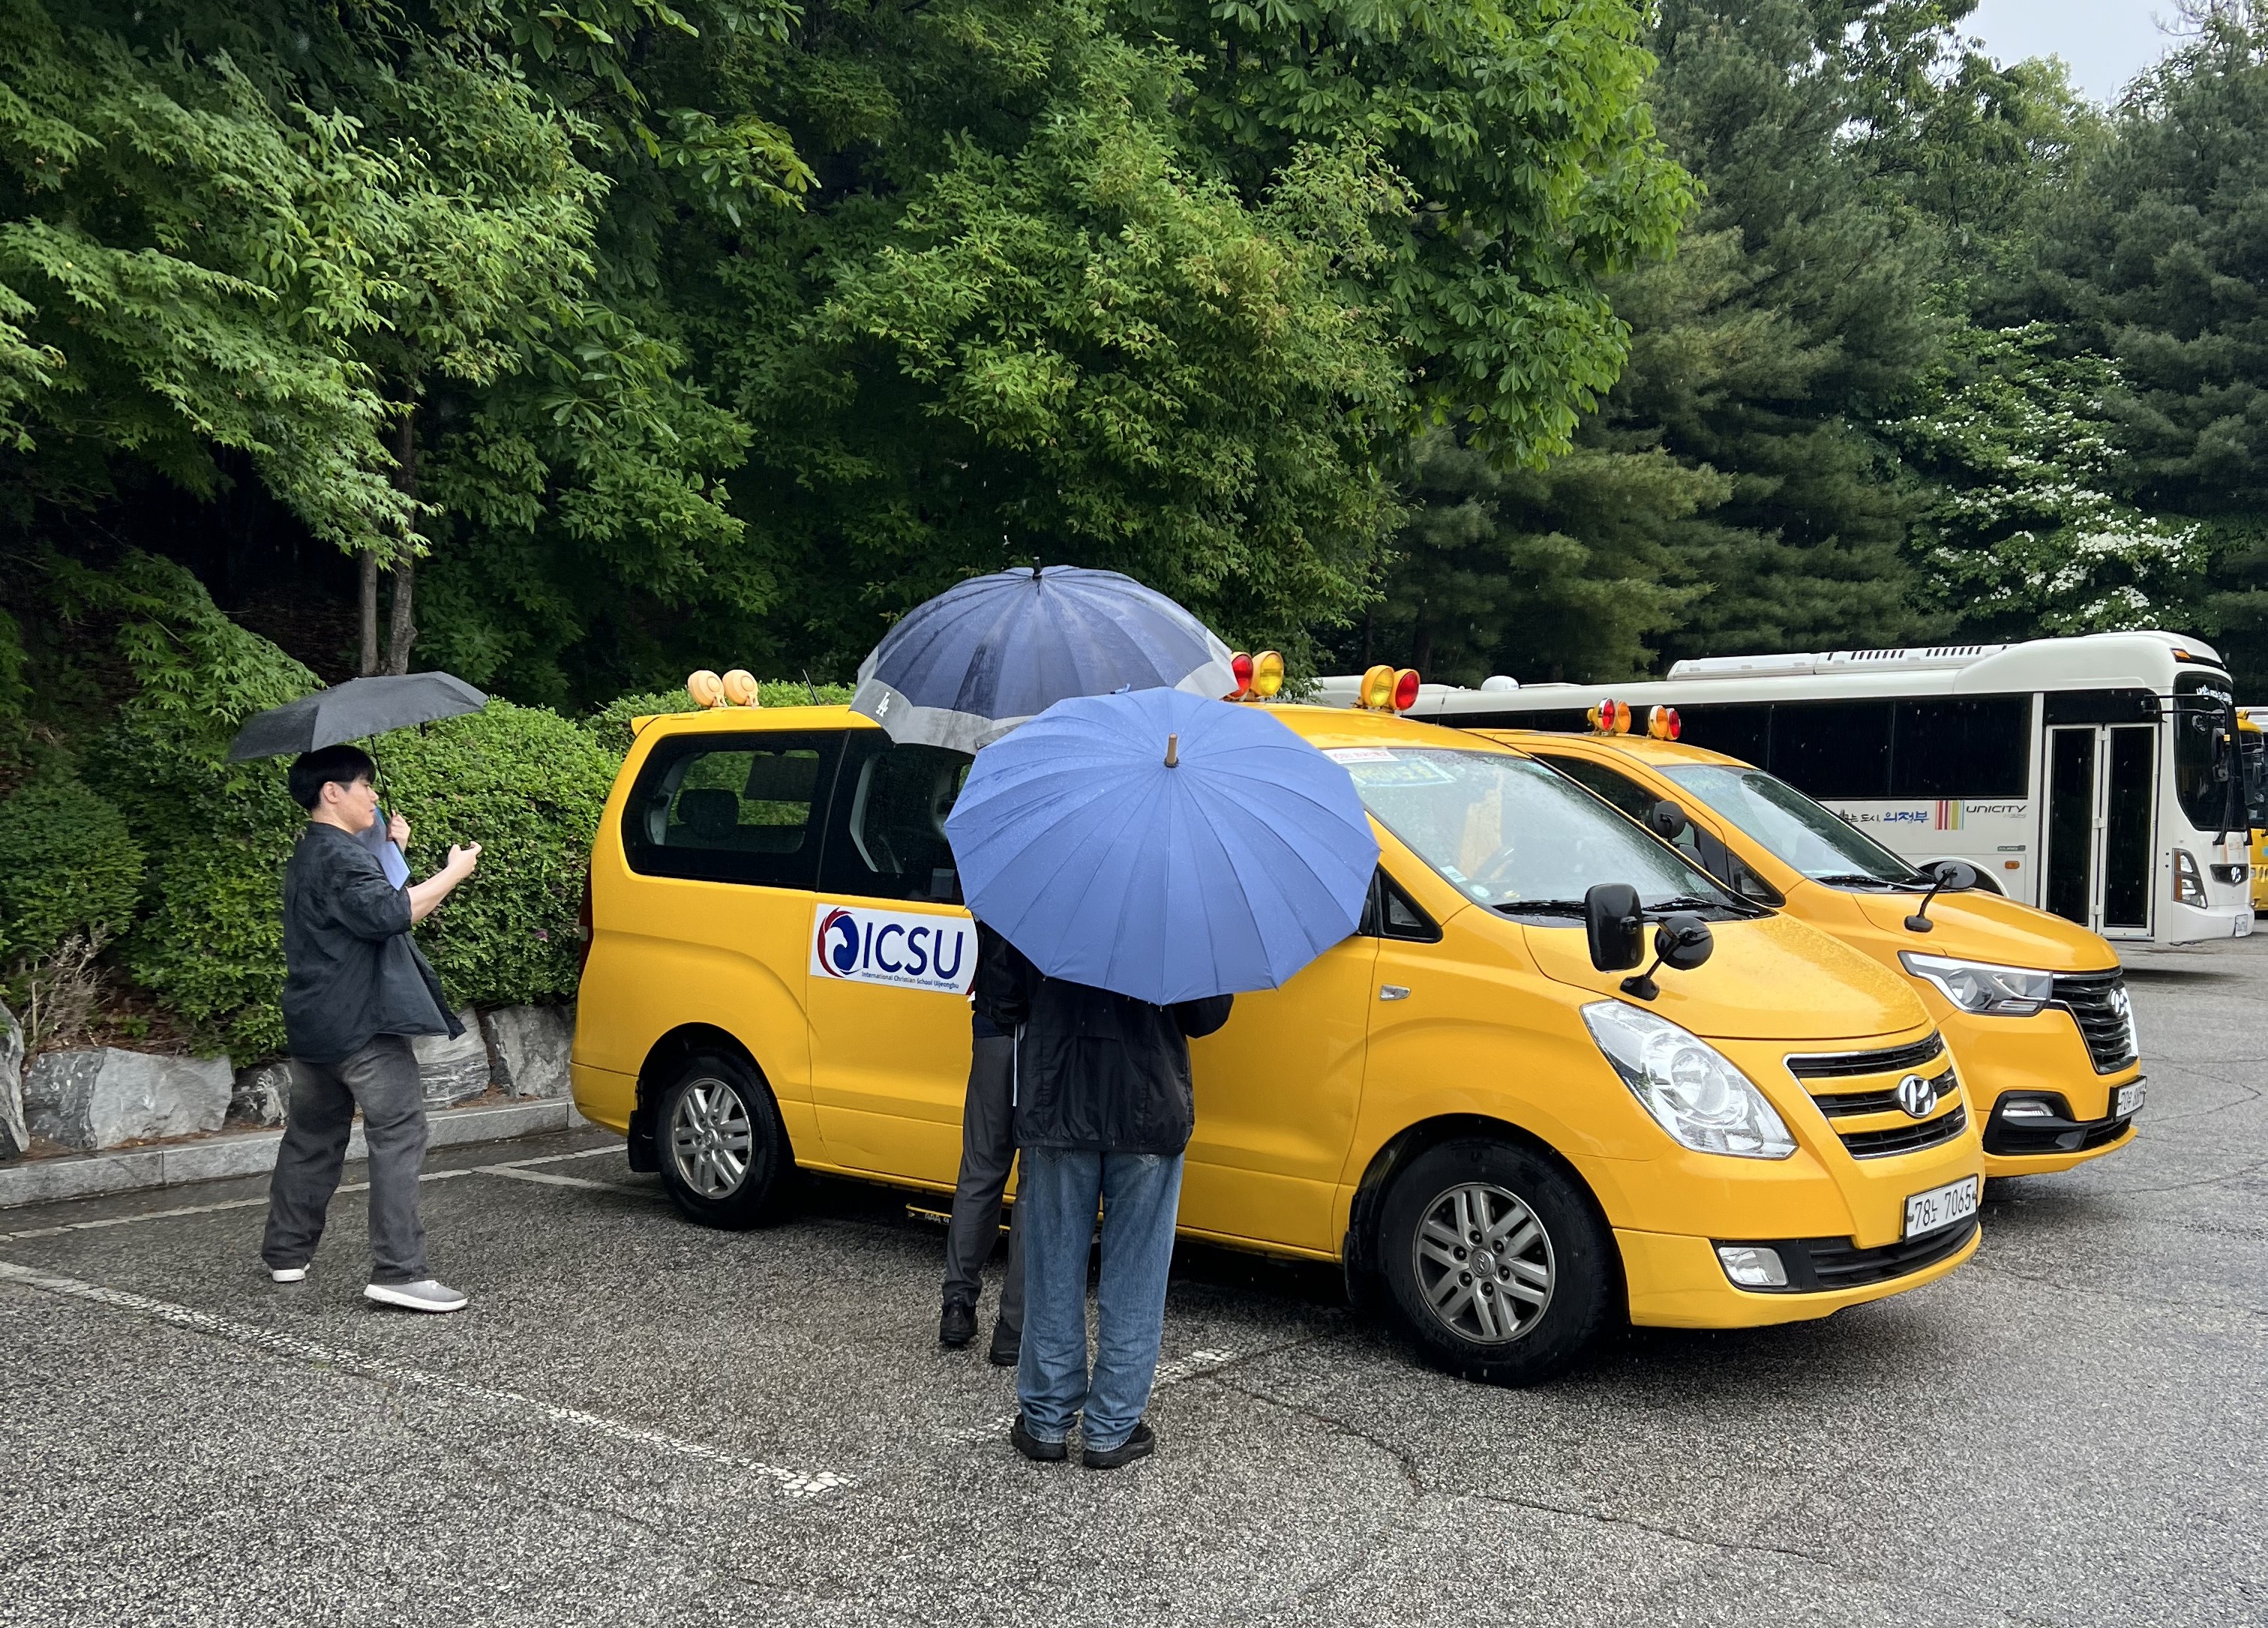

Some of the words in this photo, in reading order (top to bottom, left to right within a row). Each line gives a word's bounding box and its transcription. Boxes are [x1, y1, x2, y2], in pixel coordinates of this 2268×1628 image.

[875, 691, 890, 718] LA
[1883, 811, 1930, 824] 의정부
[1966, 805, 2027, 814] UNICITY
[862, 922, 964, 979] ICSU
[861, 971, 893, 981] International
[893, 975, 916, 984] Christian
[916, 978, 933, 986] School
[933, 980, 959, 989] Uijeongbu
[1915, 1198, 1939, 1230] 78노
[1945, 1184, 1972, 1219] 7065
